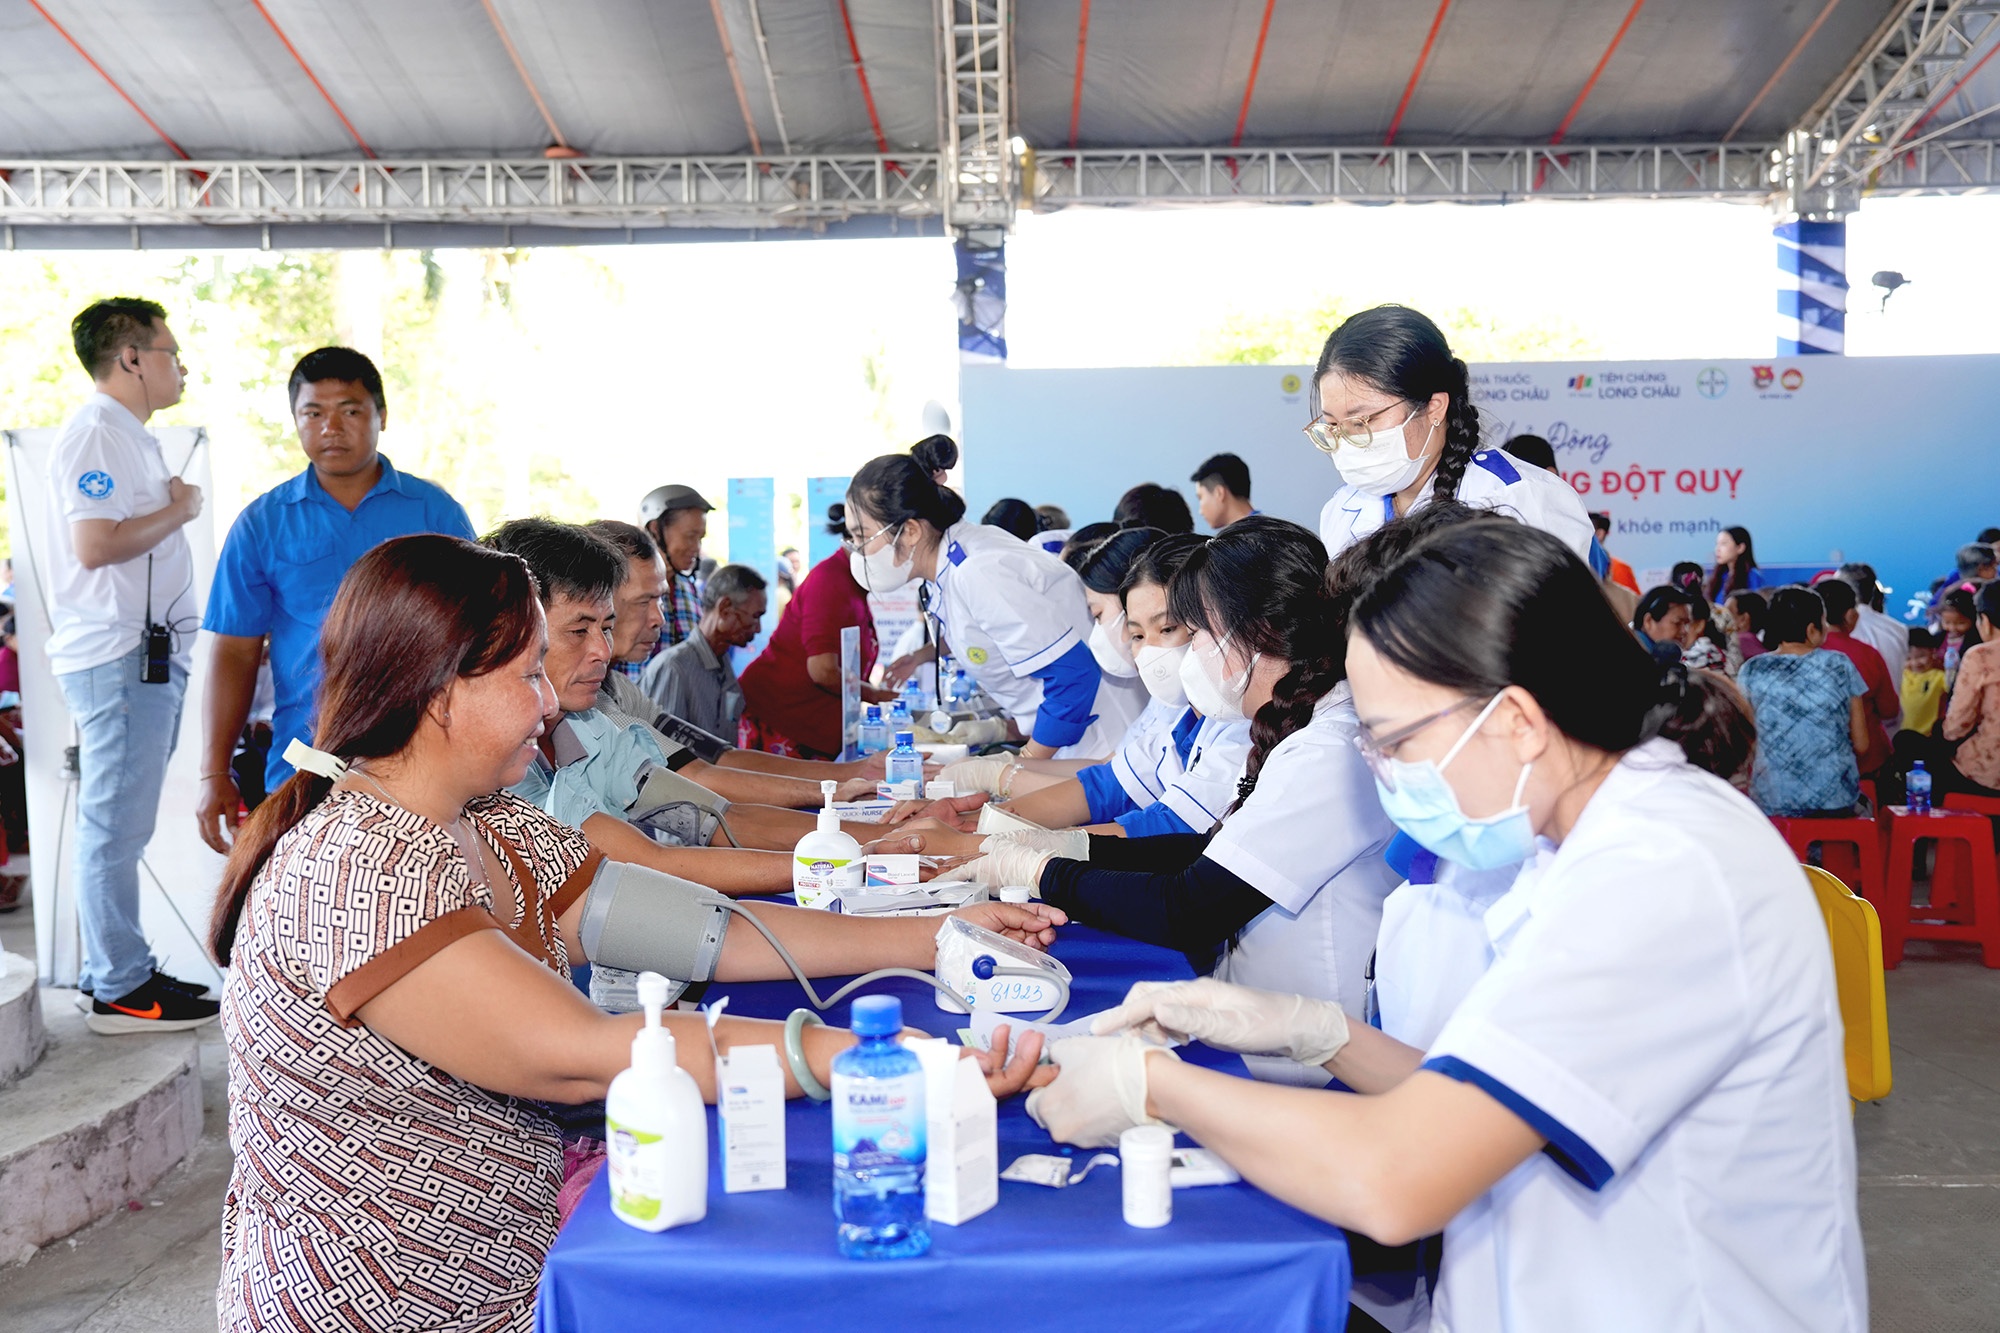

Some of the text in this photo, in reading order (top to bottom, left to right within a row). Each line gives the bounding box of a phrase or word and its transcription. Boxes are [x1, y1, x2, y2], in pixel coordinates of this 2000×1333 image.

[1598, 386, 1639, 400] LONG
[1641, 384, 1682, 399] CHÂU
[1600, 464, 1666, 500] ĐỘT
[1675, 468, 1744, 499] QUỴ
[1669, 517, 1721, 536] mạnh
[990, 981, 1043, 1003] 81923
